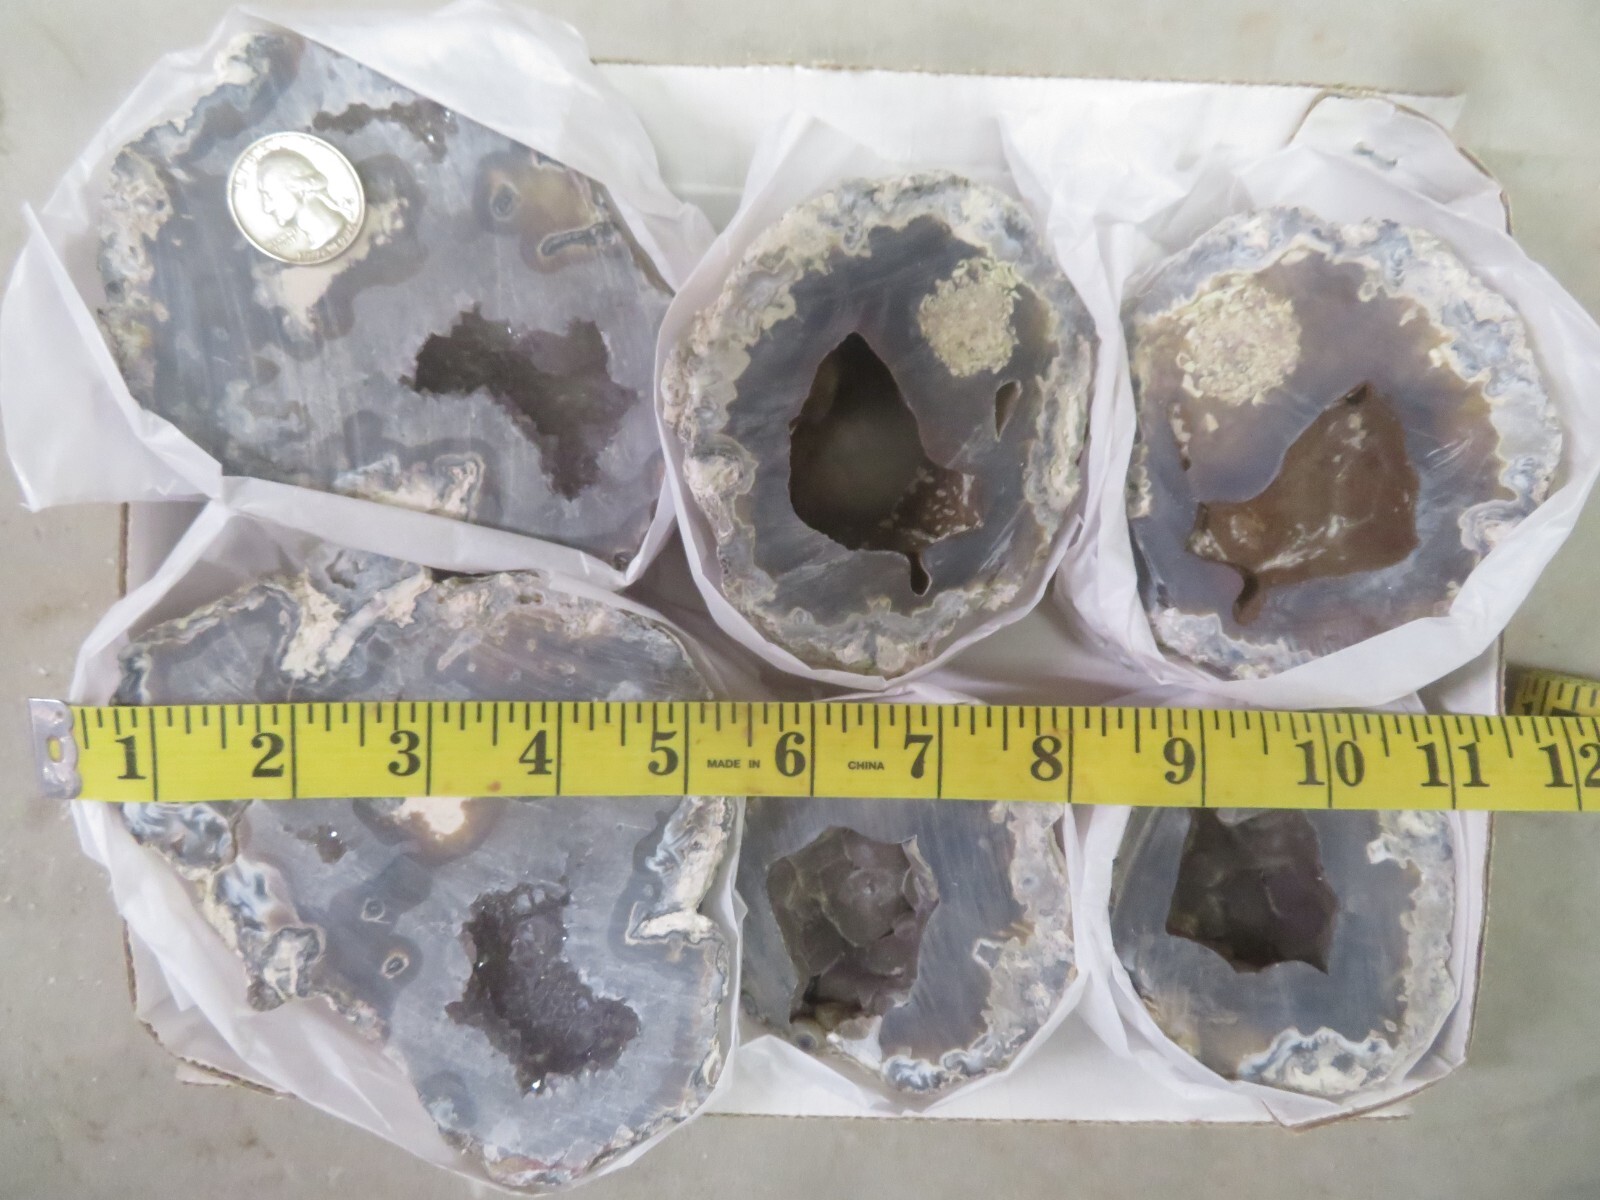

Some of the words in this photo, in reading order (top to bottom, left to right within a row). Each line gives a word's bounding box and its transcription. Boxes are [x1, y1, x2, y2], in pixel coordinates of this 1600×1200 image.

[115, 735, 147, 780] 1
[250, 732, 284, 778] 2
[387, 730, 421, 777] 3
[518, 730, 553, 775] 4
[648, 731, 679, 776] 5
[775, 731, 806, 777] 6
[904, 734, 933, 779] 7
[1030, 735, 1063, 782] 8
[1163, 737, 1196, 784] 9
[1295, 740, 1365, 787] 10
[1416, 741, 1490, 787] 11
[707, 759, 741, 769] MADE
[748, 759, 761, 769] IN
[847, 761, 885, 770] CHINA
